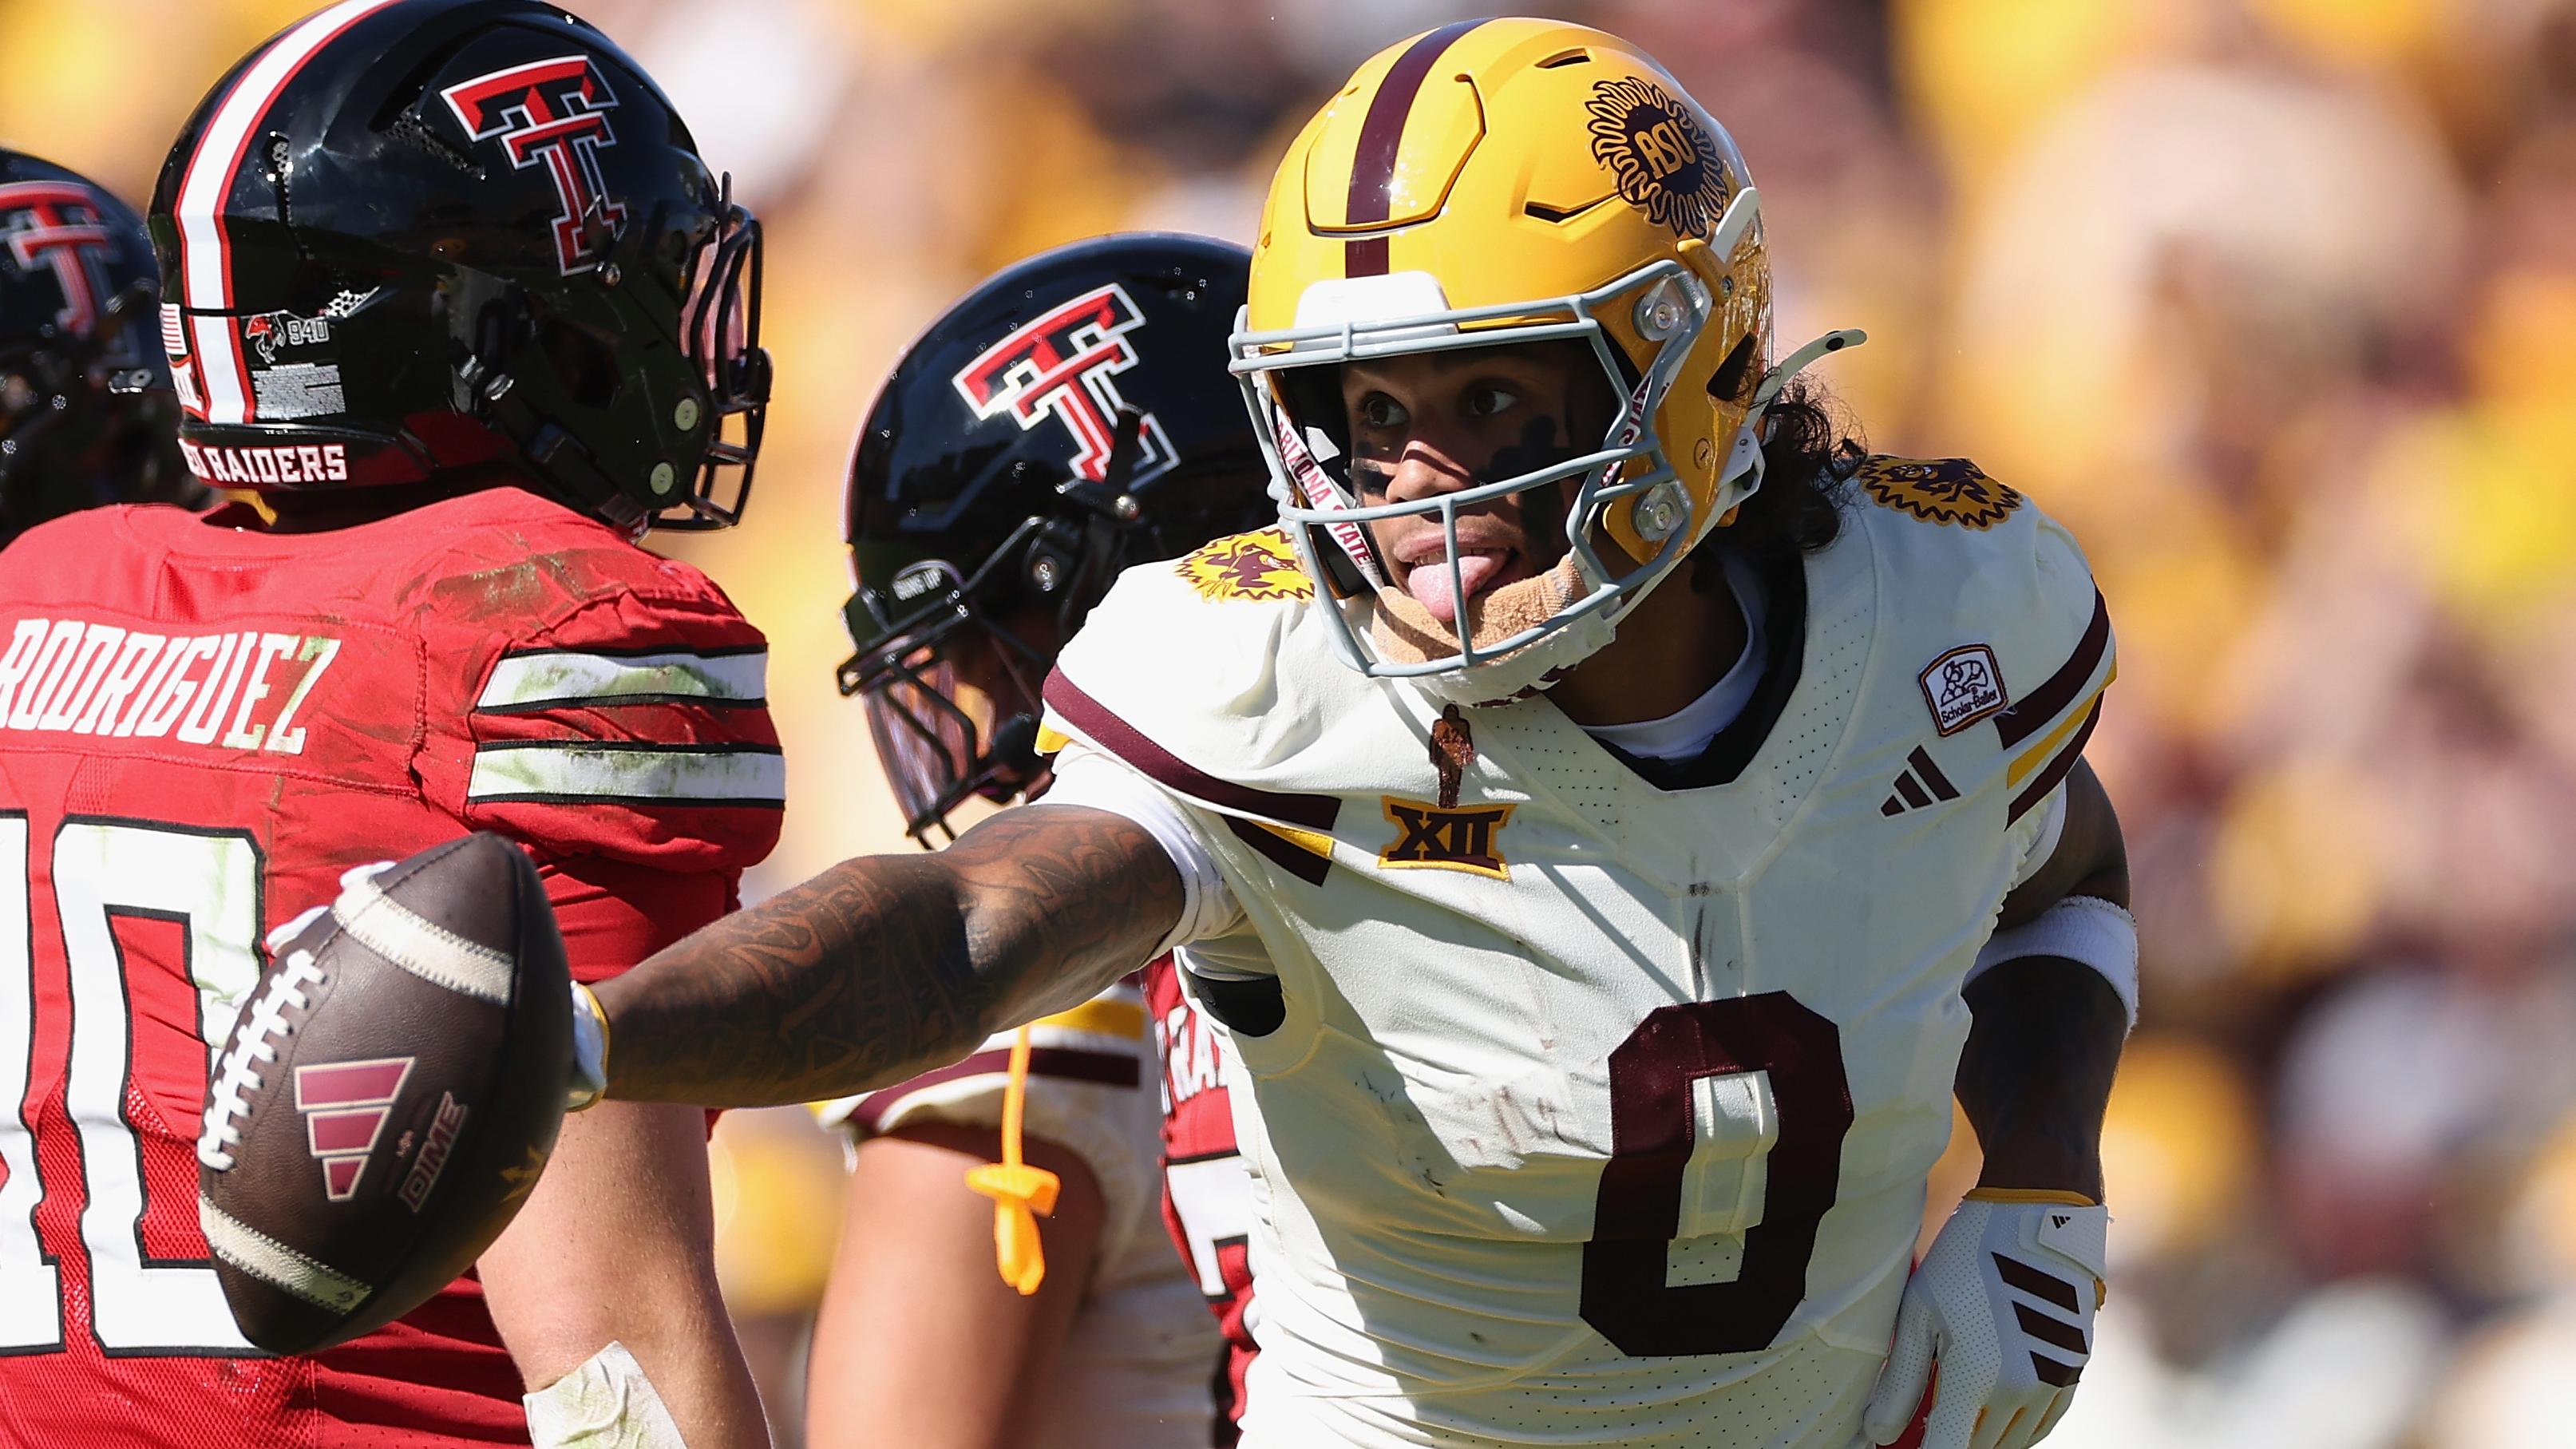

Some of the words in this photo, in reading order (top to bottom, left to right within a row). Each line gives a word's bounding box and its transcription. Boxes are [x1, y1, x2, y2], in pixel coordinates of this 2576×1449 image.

[1634, 119, 1696, 180] ASU
[287, 319, 330, 346] 940
[204, 445, 347, 482] RAIDERS
[0, 618, 341, 754] RODRIGUEZ
[1384, 802, 1507, 873] XII
[398, 1090, 468, 1213] DIME
[1580, 991, 1854, 1357] 0
